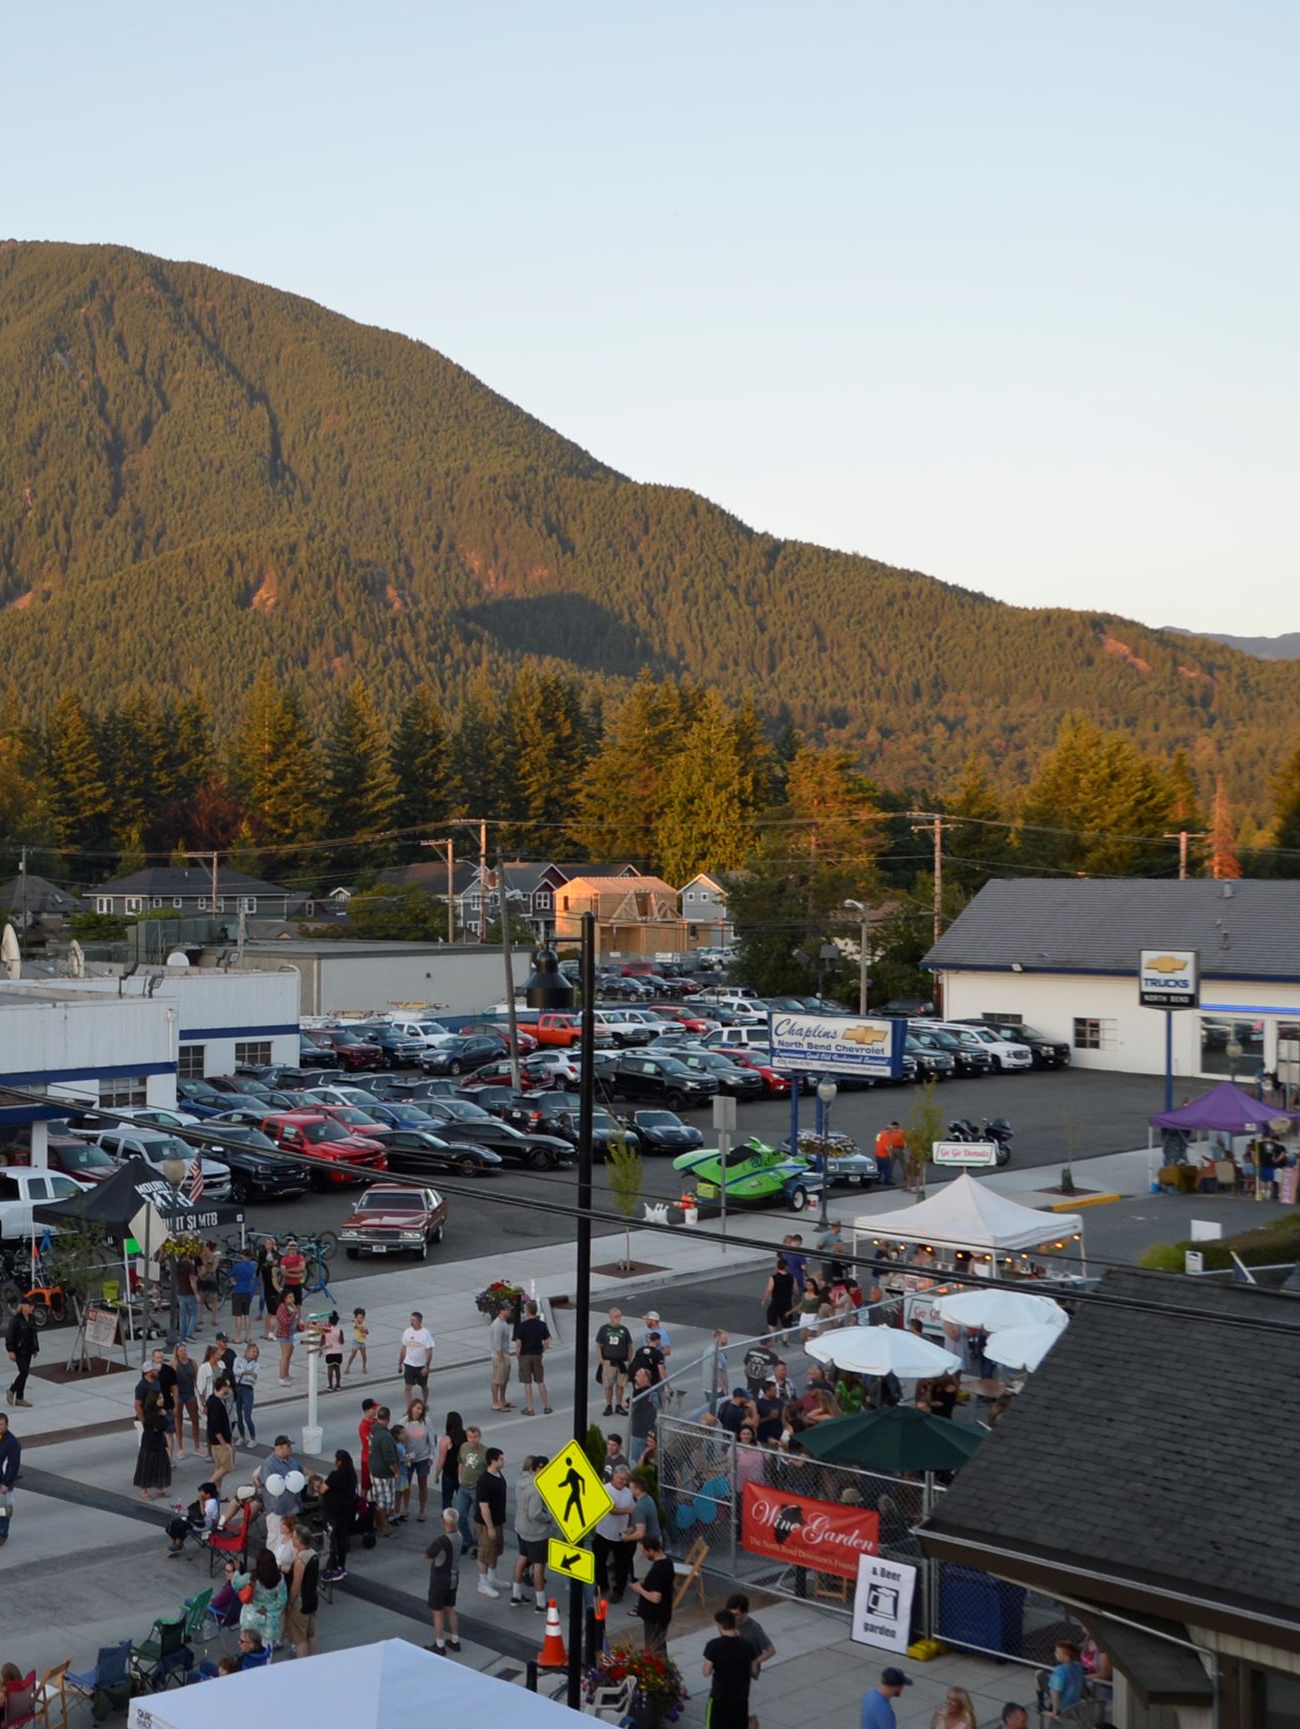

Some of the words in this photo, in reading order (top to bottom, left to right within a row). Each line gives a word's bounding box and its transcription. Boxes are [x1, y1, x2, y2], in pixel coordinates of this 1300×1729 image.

[1143, 978, 1190, 989] TRUCKS
[773, 1017, 839, 1041] Chaplins
[777, 1039, 805, 1049] North
[806, 1041, 832, 1051] Bend
[834, 1043, 886, 1056] Chevrolet
[199, 1211, 218, 1228] MTB
[751, 1499, 801, 1534] Wine
[801, 1511, 875, 1552] Garden
[871, 1566, 878, 1576] &
[880, 1567, 902, 1582] Beer
[863, 1621, 898, 1640] garden
